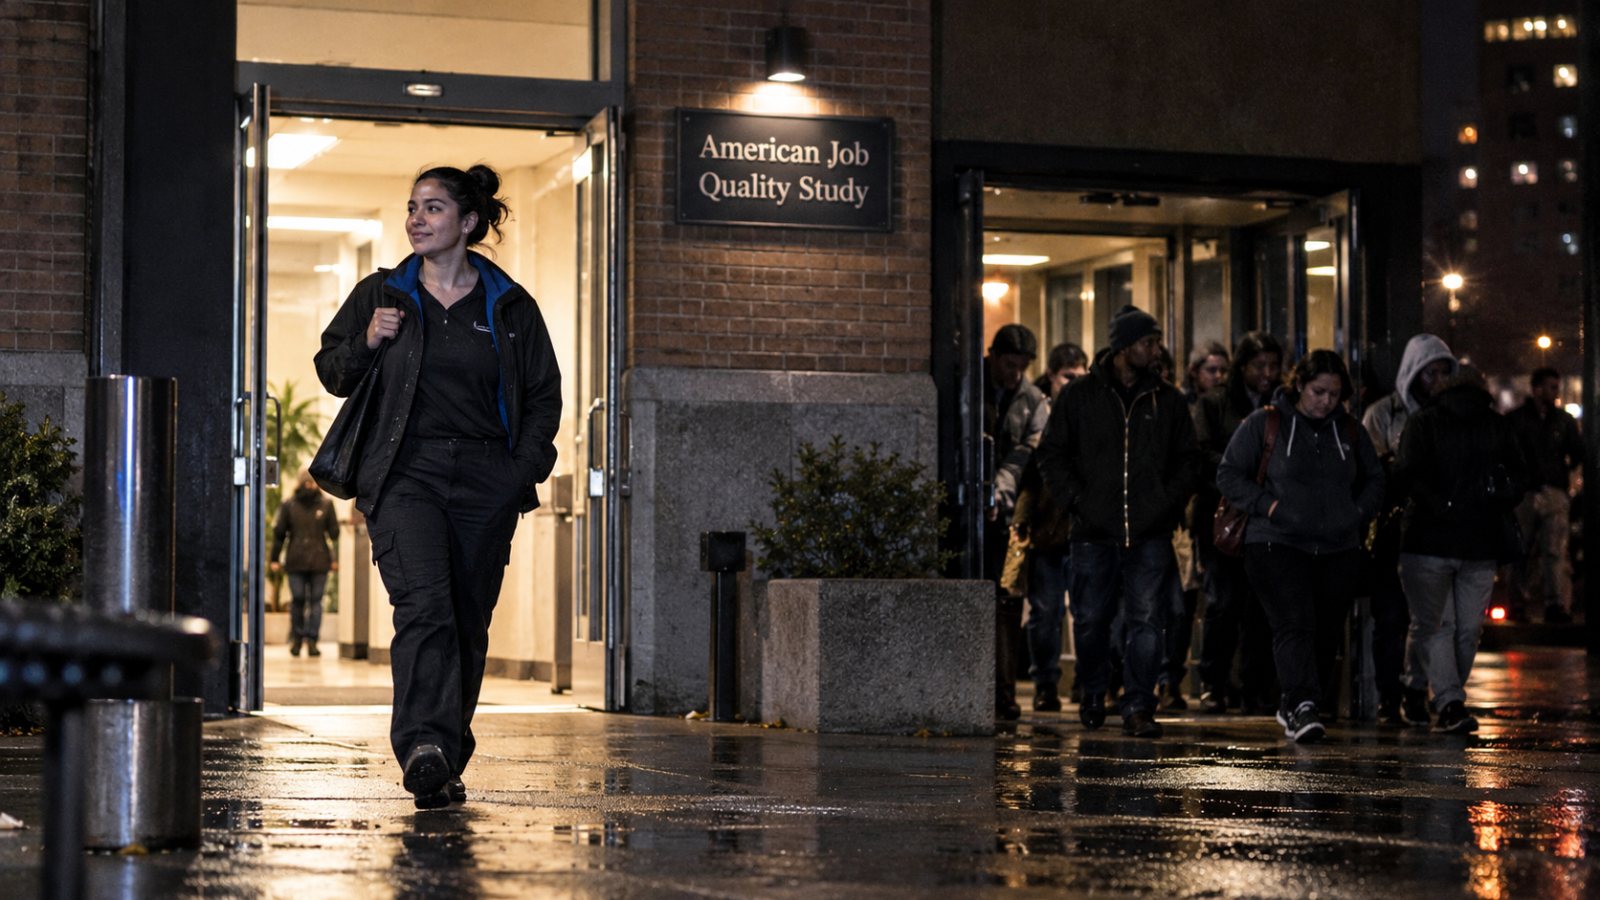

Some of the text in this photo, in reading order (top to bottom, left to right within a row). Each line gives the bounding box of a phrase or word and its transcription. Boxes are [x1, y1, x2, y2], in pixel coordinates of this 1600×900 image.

[700, 134, 870, 169] American Job
[699, 171, 870, 209] Quality Study
